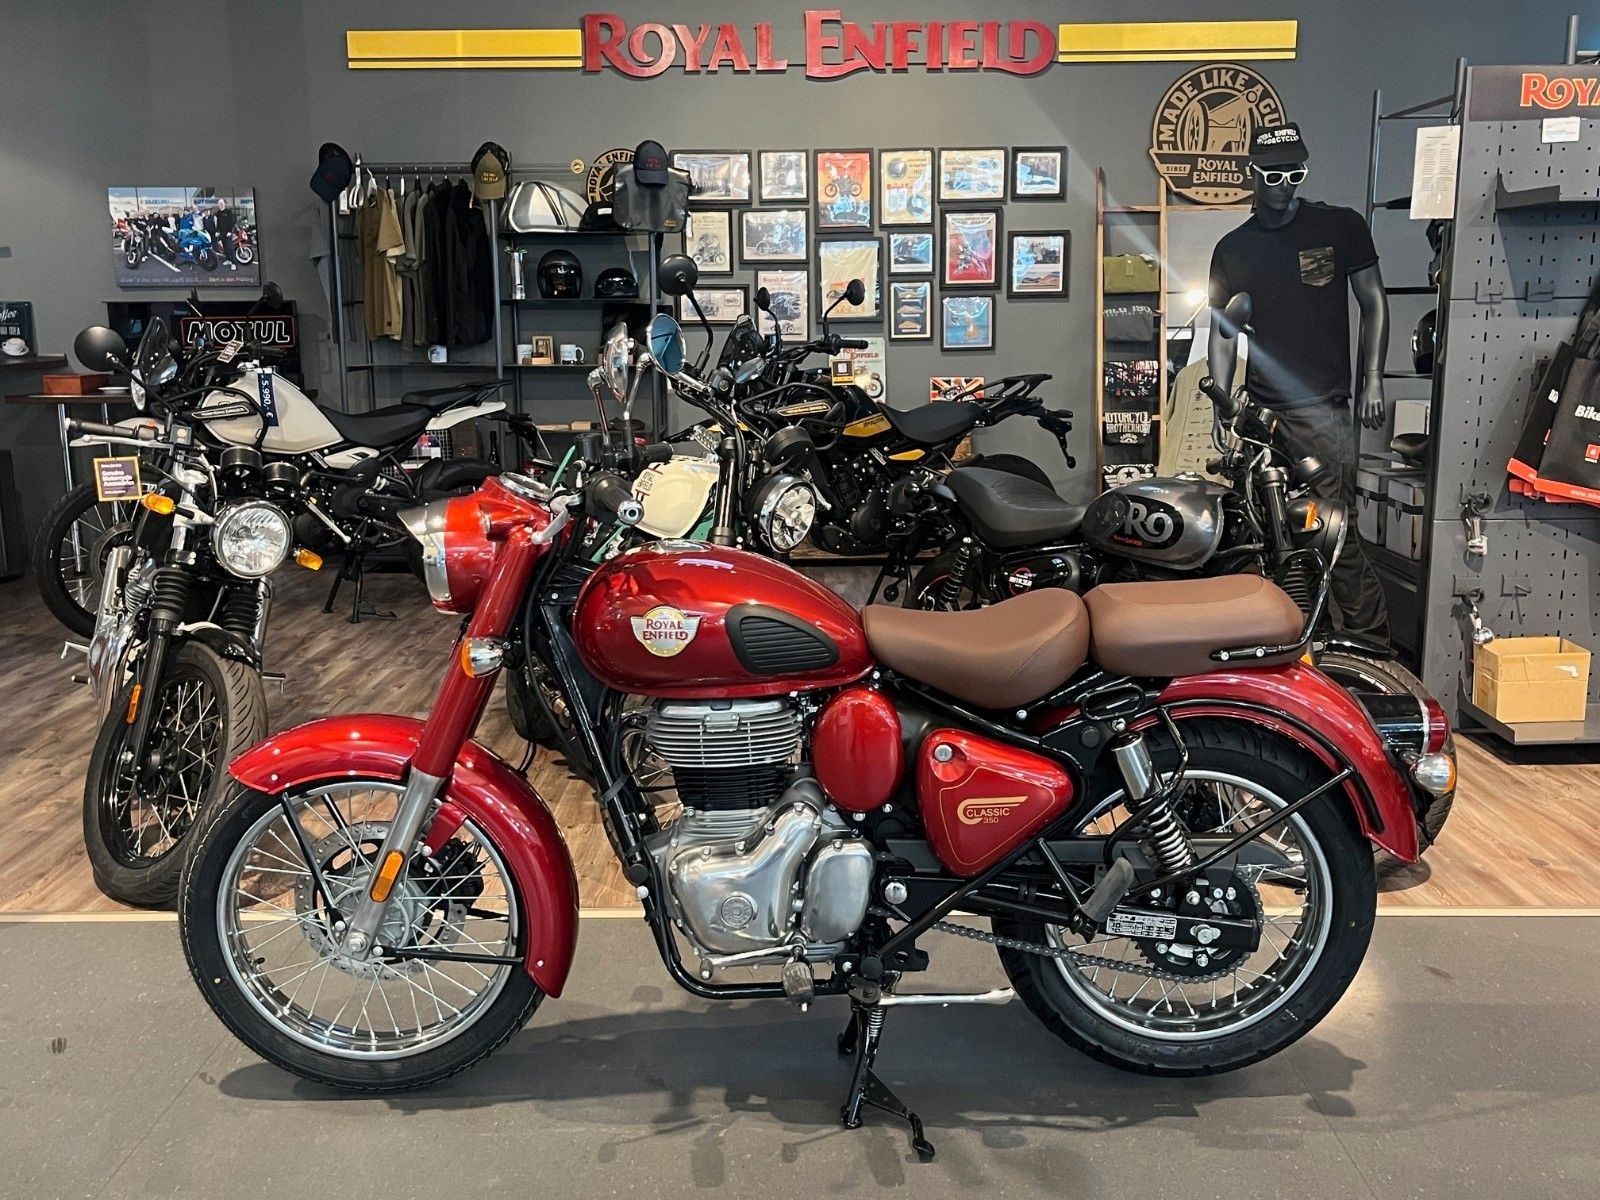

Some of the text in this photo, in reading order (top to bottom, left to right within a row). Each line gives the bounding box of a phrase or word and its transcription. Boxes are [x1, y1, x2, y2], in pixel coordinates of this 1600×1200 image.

[583, 9, 1057, 78] ROYAL ENFIELD
[1159, 80, 1198, 141] MADE
[1199, 69, 1249, 90] LIKE
[1258, 98, 1281, 128] GU
[606, 151, 635, 163] ENFIE
[1197, 158, 1239, 171] ROYAL
[1192, 171, 1244, 184] ENFIELD
[187, 321, 290, 344] MOTUL
[646, 618, 684, 630] ROYAL
[642, 630, 689, 641] ENFIELD
[966, 808, 1010, 817] CLASSIC
[983, 816, 999, 824] 350
